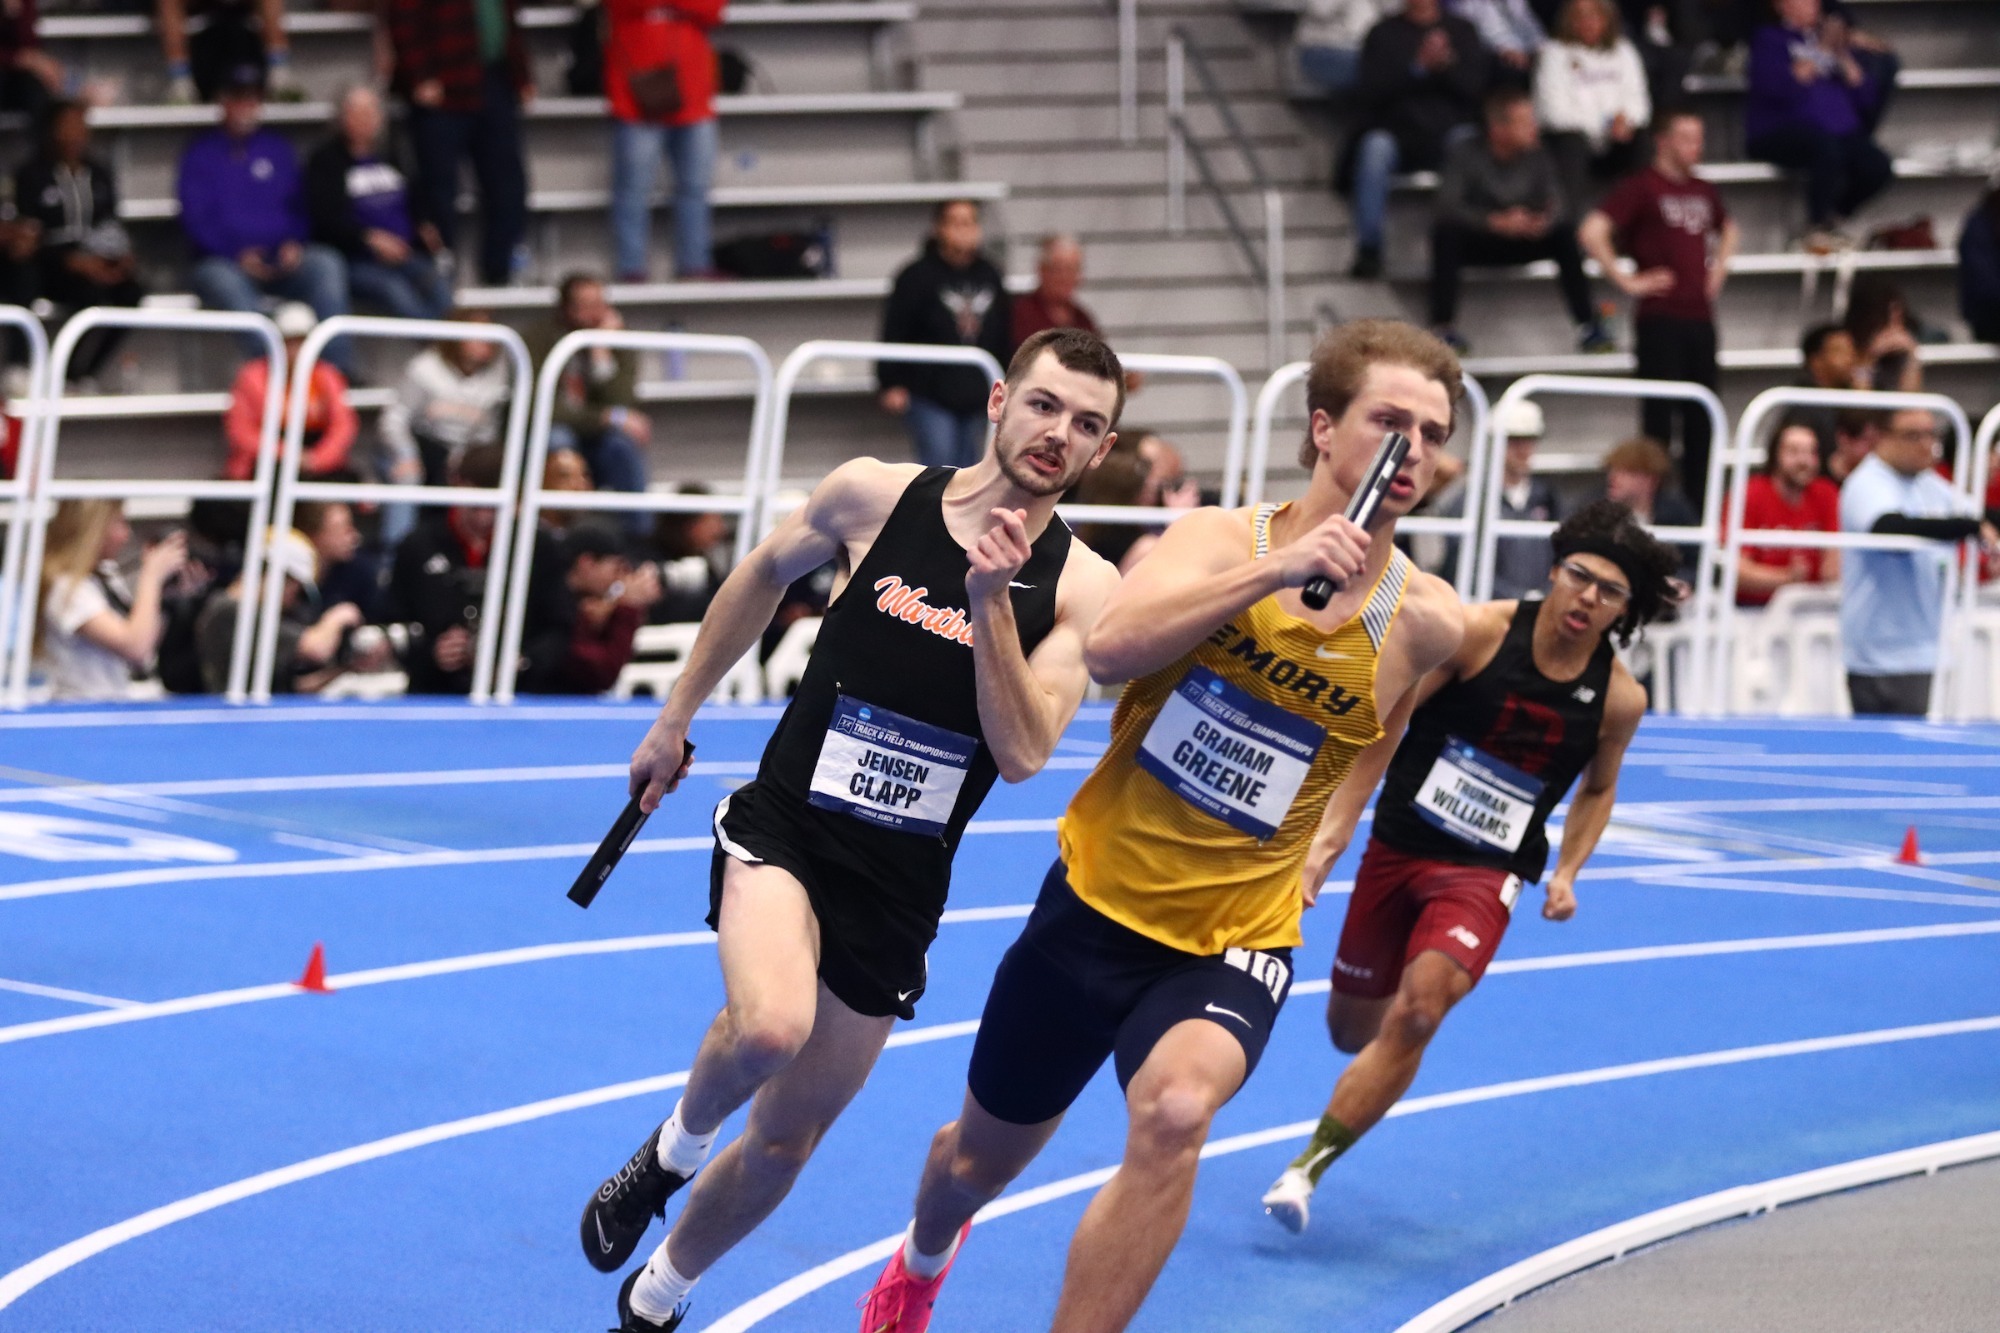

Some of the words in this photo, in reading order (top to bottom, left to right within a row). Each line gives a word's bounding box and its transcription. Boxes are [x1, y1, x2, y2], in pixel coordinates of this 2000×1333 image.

[853, 722, 878, 737] TRACK
[884, 734, 904, 747] FIELD
[904, 739, 967, 763] CHAMPIONSHIPS
[1192, 720, 1276, 777] GRAHAM
[1200, 693, 1226, 716] TRACK
[1229, 713, 1253, 730] FIELD
[1249, 722, 1315, 757] CHAMPIONSHIPS
[849, 772, 922, 809] CLAPP
[858, 749, 930, 785] JENSEN
[1172, 739, 1267, 808] GREENE
[1432, 787, 1511, 840] WILLIAMS
[1454, 777, 1510, 815] TRUMAN
